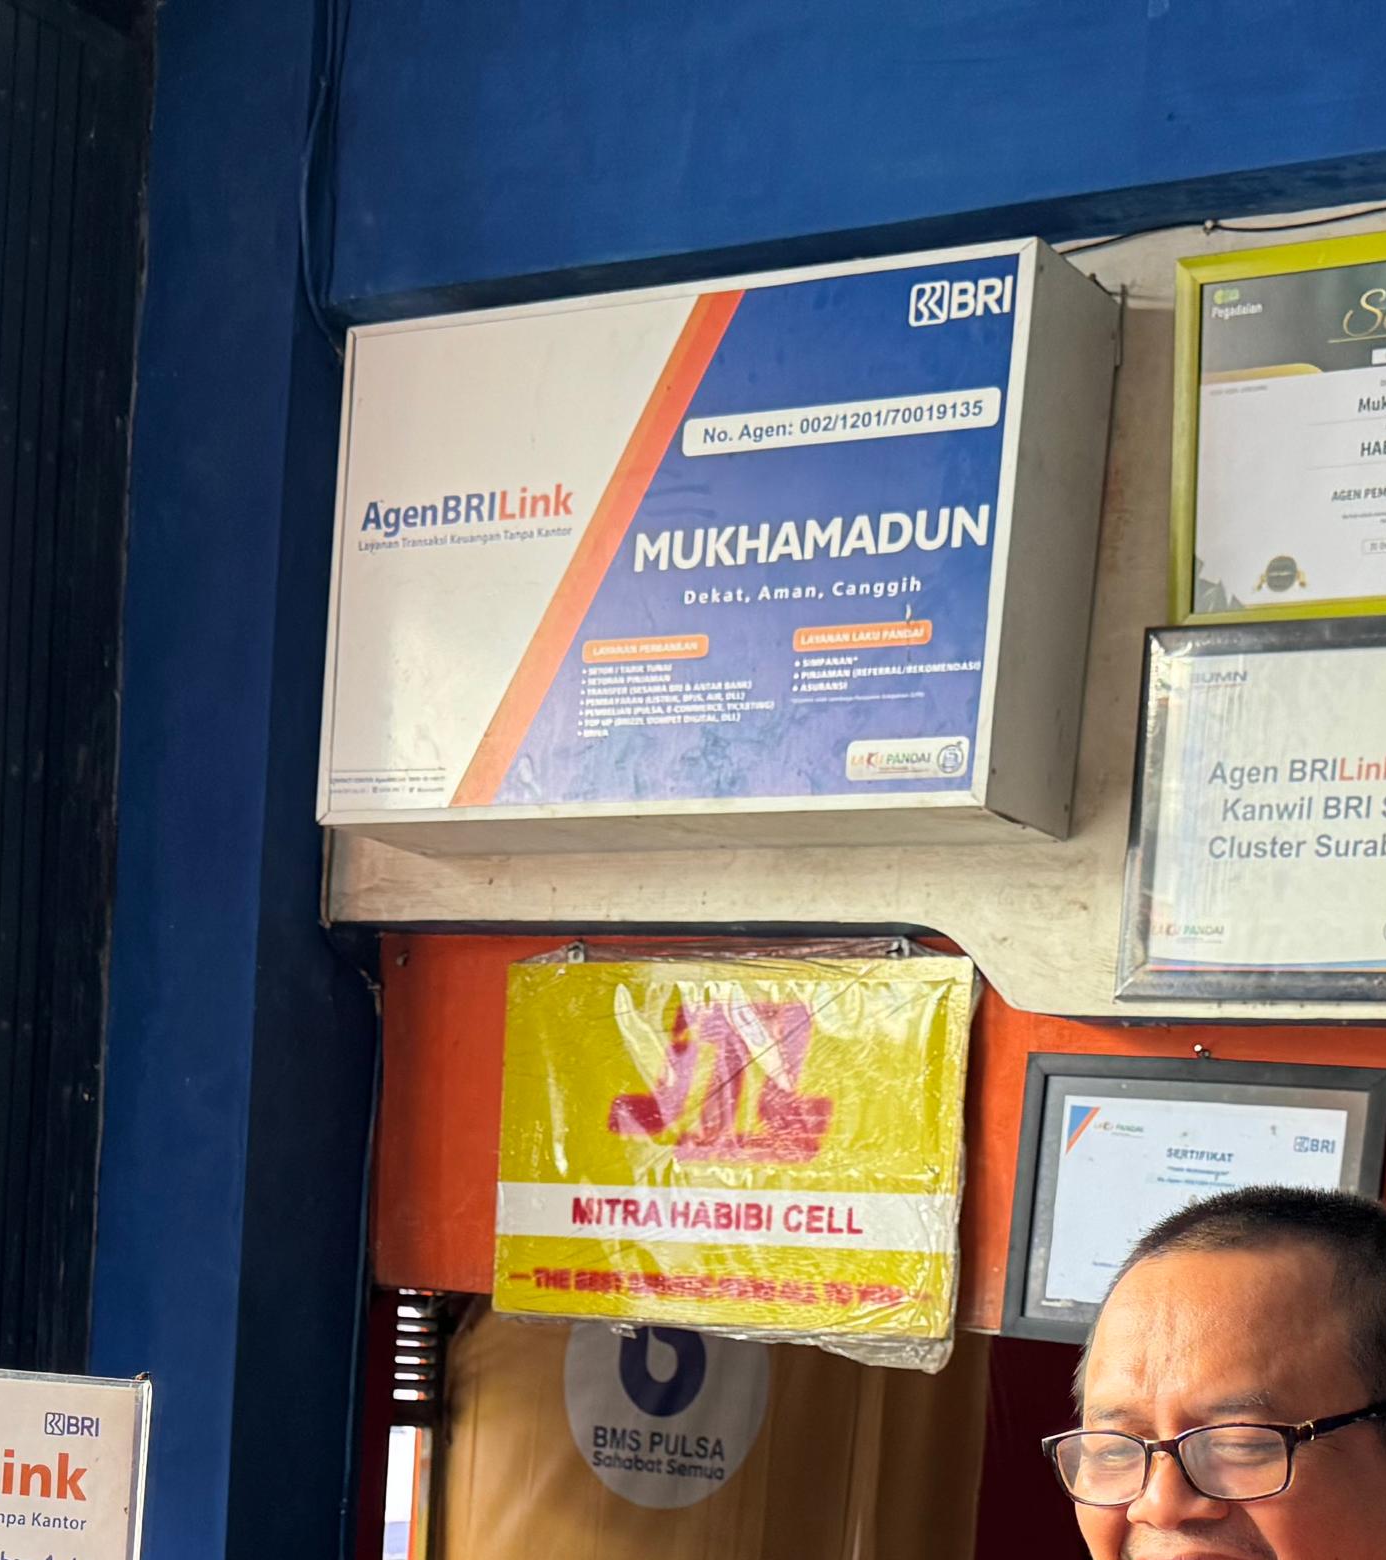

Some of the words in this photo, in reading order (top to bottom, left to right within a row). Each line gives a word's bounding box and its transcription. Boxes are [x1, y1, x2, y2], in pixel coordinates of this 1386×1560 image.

[951, 276, 1013, 318] BRI
[702, 424, 733, 444] No.
[739, 419, 794, 441] Agen:
[800, 400, 983, 435] 002/1201/70019135
[1331, 490, 1361, 501] AGEN
[361, 484, 573, 538] AgenBRILink
[358, 540, 399, 552] Layanan
[402, 536, 447, 548] Transaksi
[450, 533, 501, 546] Keuangan
[504, 530, 534, 541] Tanpa
[537, 526, 572, 538] Kantor
[634, 506, 990, 571] MUKHAMADUN
[684, 586, 751, 605] Dekat,
[759, 582, 824, 601] Aman,
[832, 576, 921, 597] Canggih
[1208, 761, 1277, 786] Agen
[1222, 799, 1312, 823] Kanwil
[1323, 797, 1371, 820] BRI
[1209, 835, 1305, 860] Cluster
[1310, 1138, 1335, 1154] BRI
[572, 1198, 662, 1229] MITRA
[671, 1201, 773, 1231] HABIBI
[783, 1205, 863, 1235] CELL
[66, 1416, 99, 1437] BRI
[593, 1426, 641, 1451] BMS
[649, 1432, 725, 1460] PULSA
[593, 1451, 662, 1473] Sahabat
[666, 1459, 725, 1480] Semua
[31, 1512, 87, 1530] Kantor
